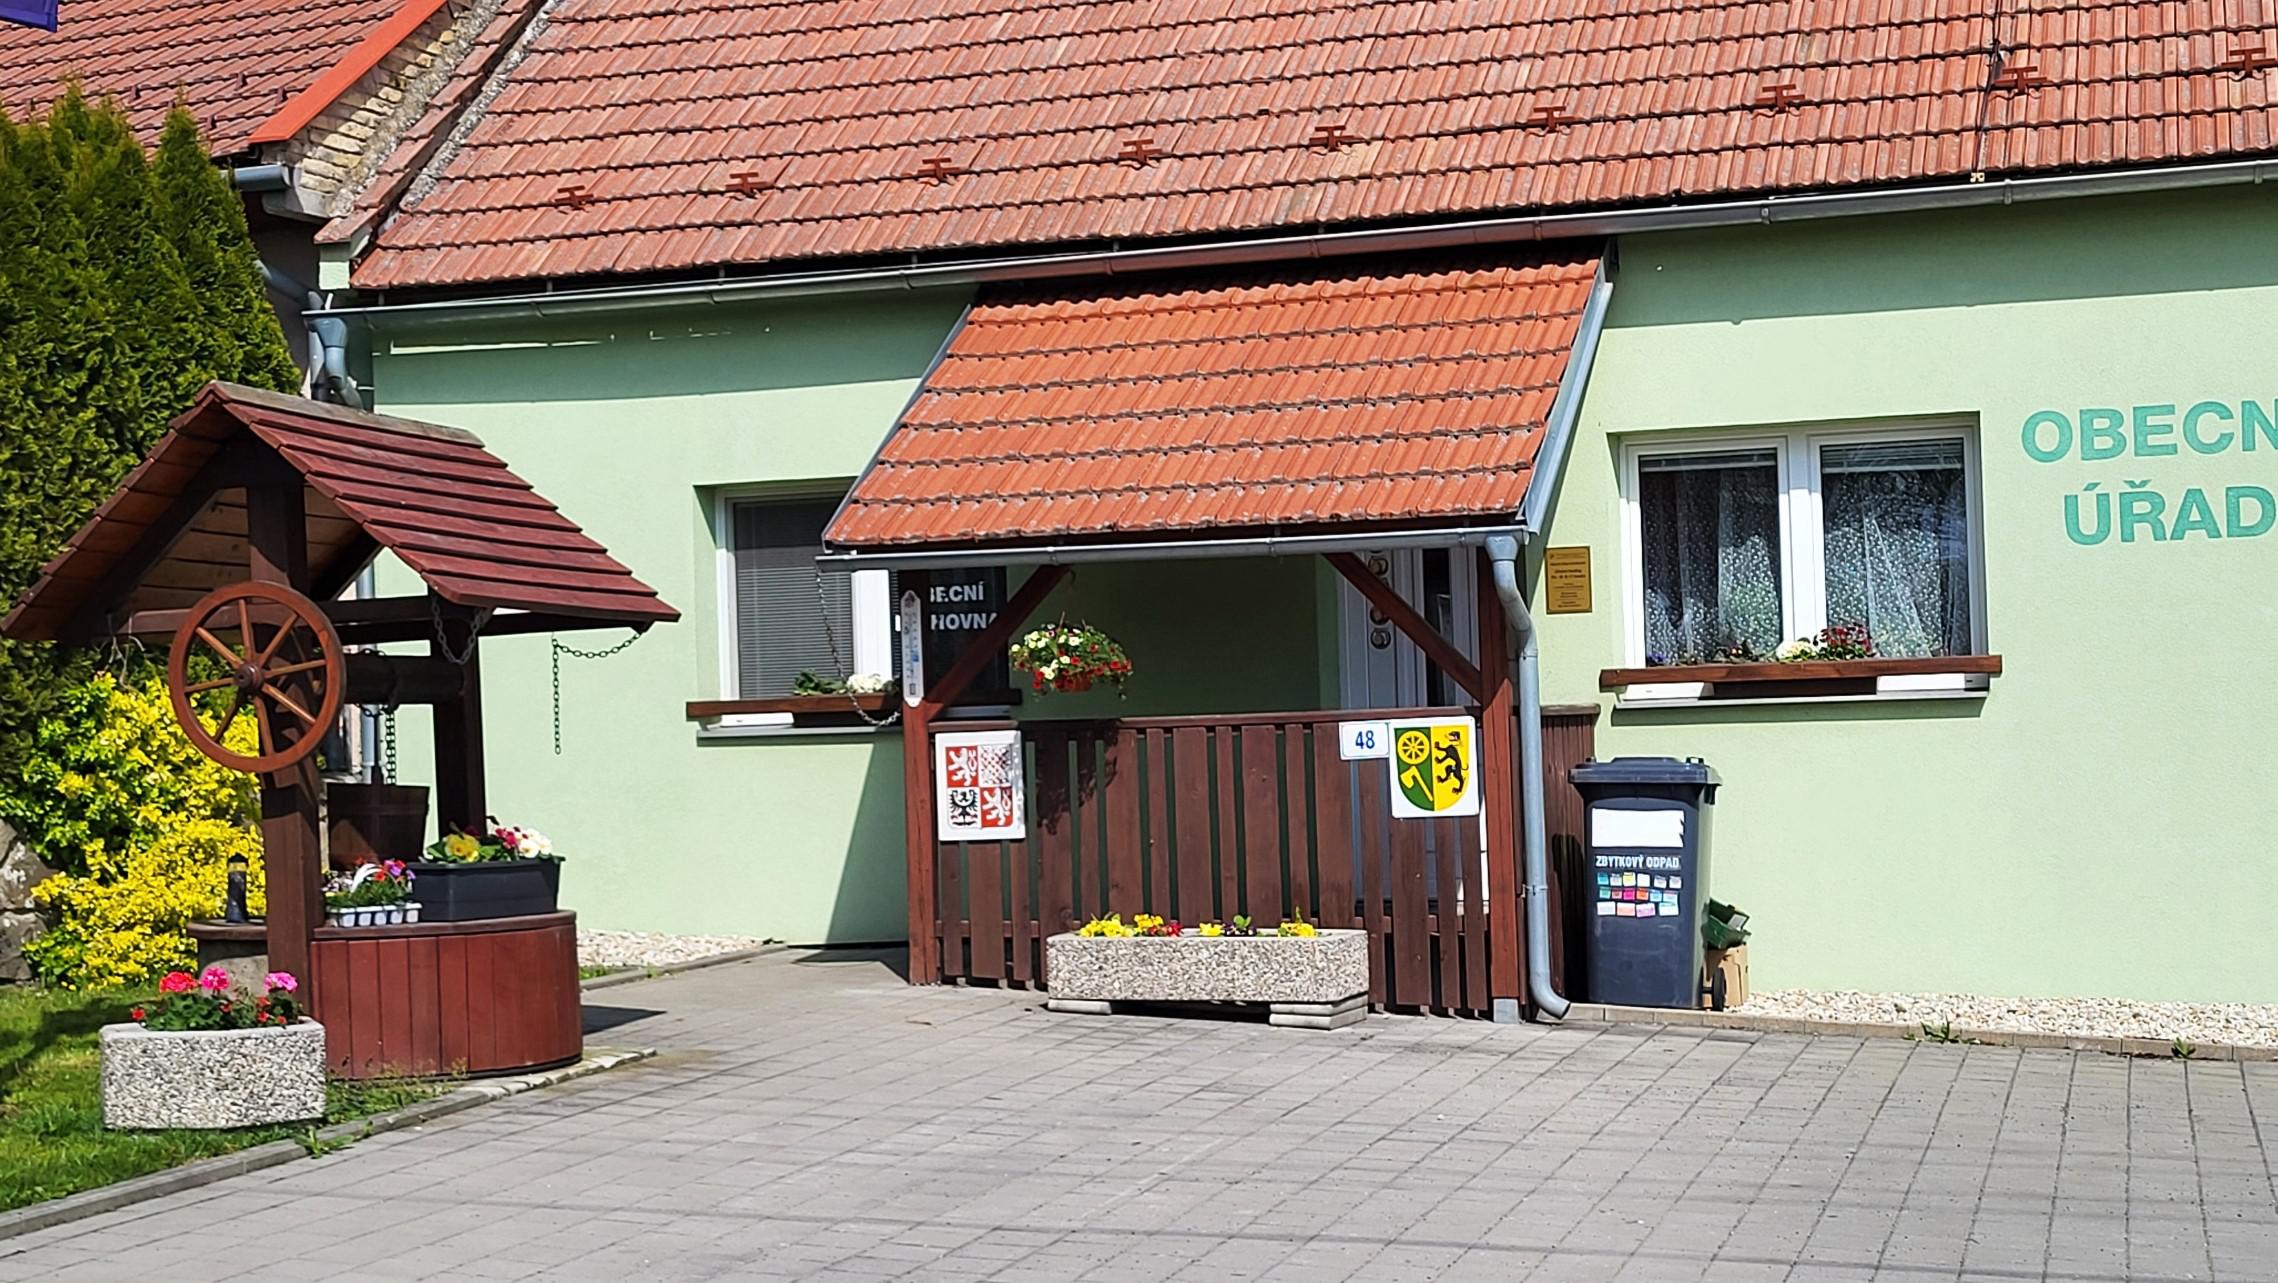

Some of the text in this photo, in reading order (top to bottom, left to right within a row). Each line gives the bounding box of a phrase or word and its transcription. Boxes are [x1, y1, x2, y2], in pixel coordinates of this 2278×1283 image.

[2063, 479, 2277, 546] ÚŘAD
[1355, 729, 1376, 750] 48
[1595, 854, 1680, 869] ZBYTKOVÝ ODPAD
